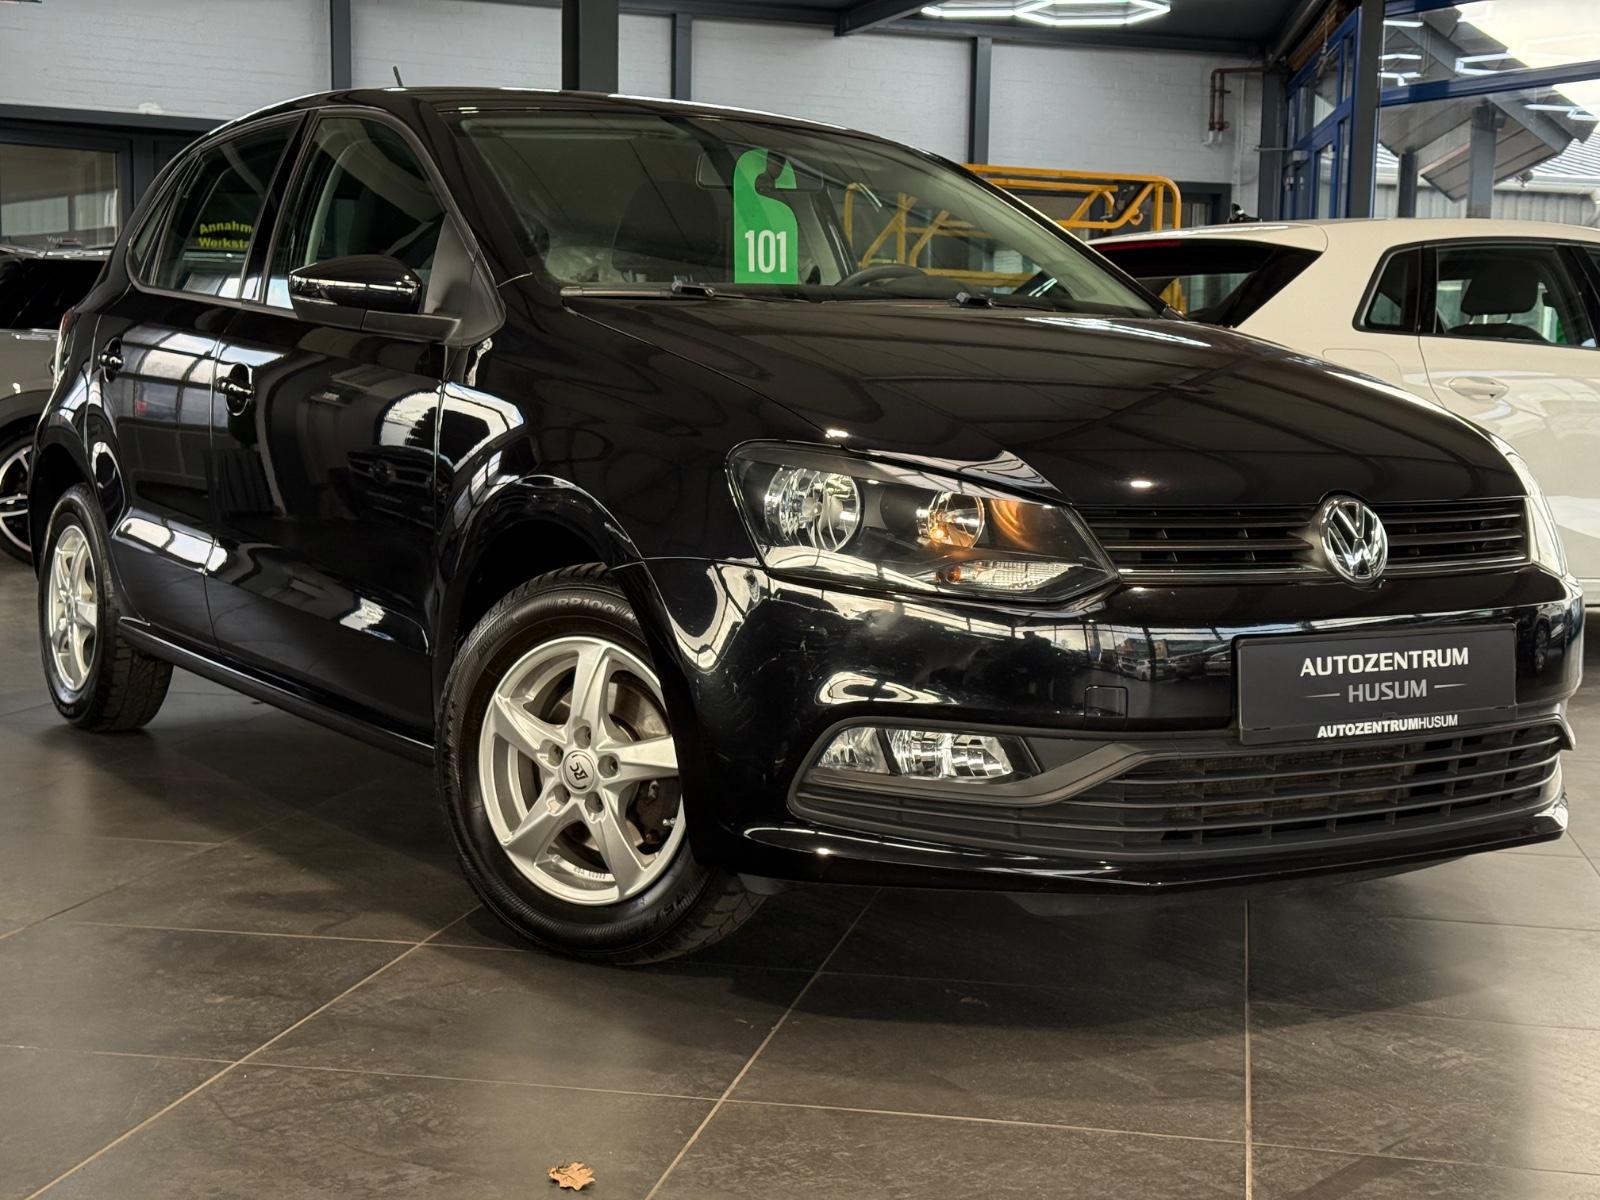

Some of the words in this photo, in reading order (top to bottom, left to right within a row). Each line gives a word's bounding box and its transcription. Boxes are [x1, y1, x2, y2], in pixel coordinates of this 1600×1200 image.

[744, 229, 787, 273] 101
[1300, 647, 1469, 677] AUTOZENTRUM
[1348, 679, 1427, 703] HUSUM
[1317, 714, 1458, 738] AUTOZENTRUMHUSUM
